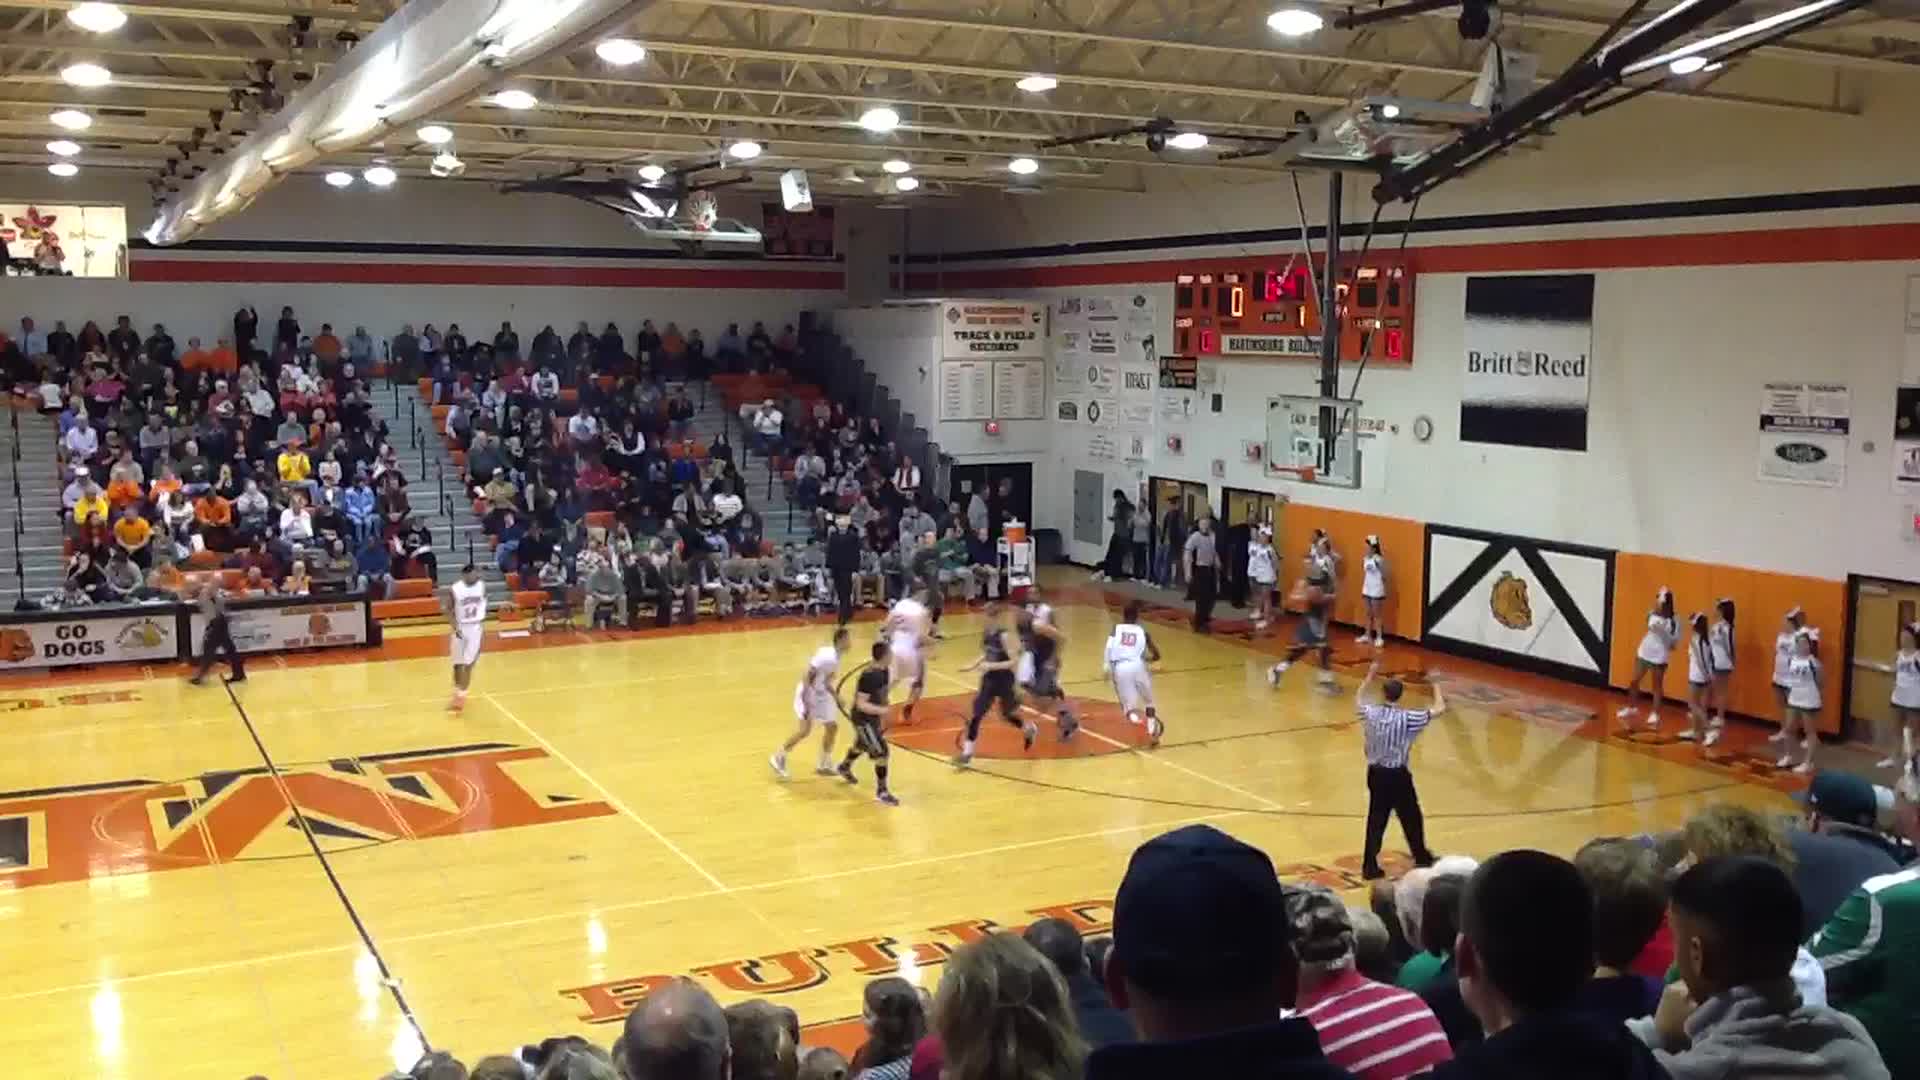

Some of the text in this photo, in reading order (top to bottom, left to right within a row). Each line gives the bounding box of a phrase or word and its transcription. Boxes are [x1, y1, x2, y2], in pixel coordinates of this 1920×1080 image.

[1231, 287, 1243, 317] 0
[953, 331, 990, 340] TRACK
[1004, 331, 1035, 340] FIELD
[970, 342, 1018, 352] RECORDS
[1468, 351, 1585, 377] Britt Reed
[55, 624, 88, 640] GO
[44, 640, 105, 658] DOGS
